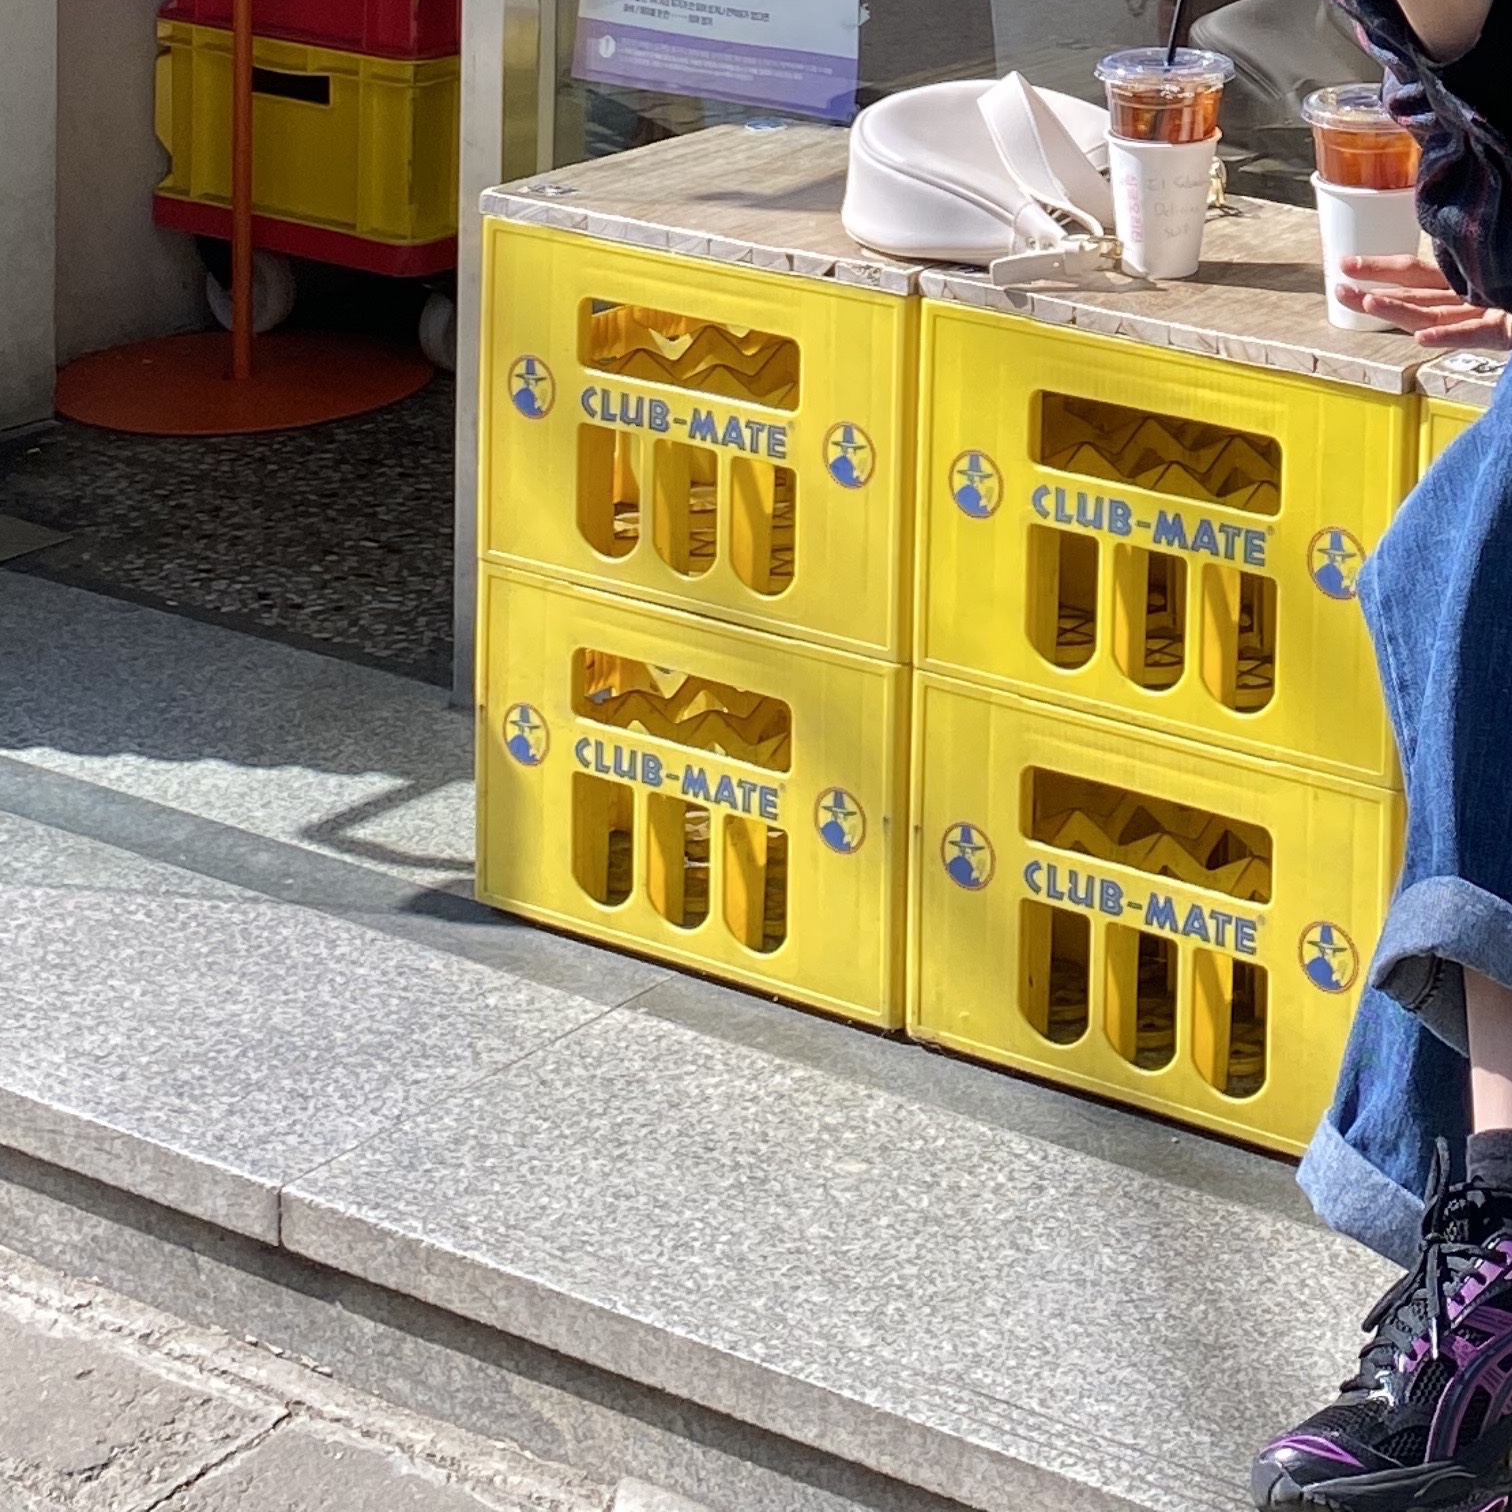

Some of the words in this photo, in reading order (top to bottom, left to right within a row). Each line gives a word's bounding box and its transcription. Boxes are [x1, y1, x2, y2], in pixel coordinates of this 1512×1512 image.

[581, 386, 788, 459] CLUB-MATE
[1032, 484, 1268, 567] CLUB-MATE
[575, 736, 780, 822] CLUB-MATE
[1024, 859, 1258, 956] CLUB-MATE
